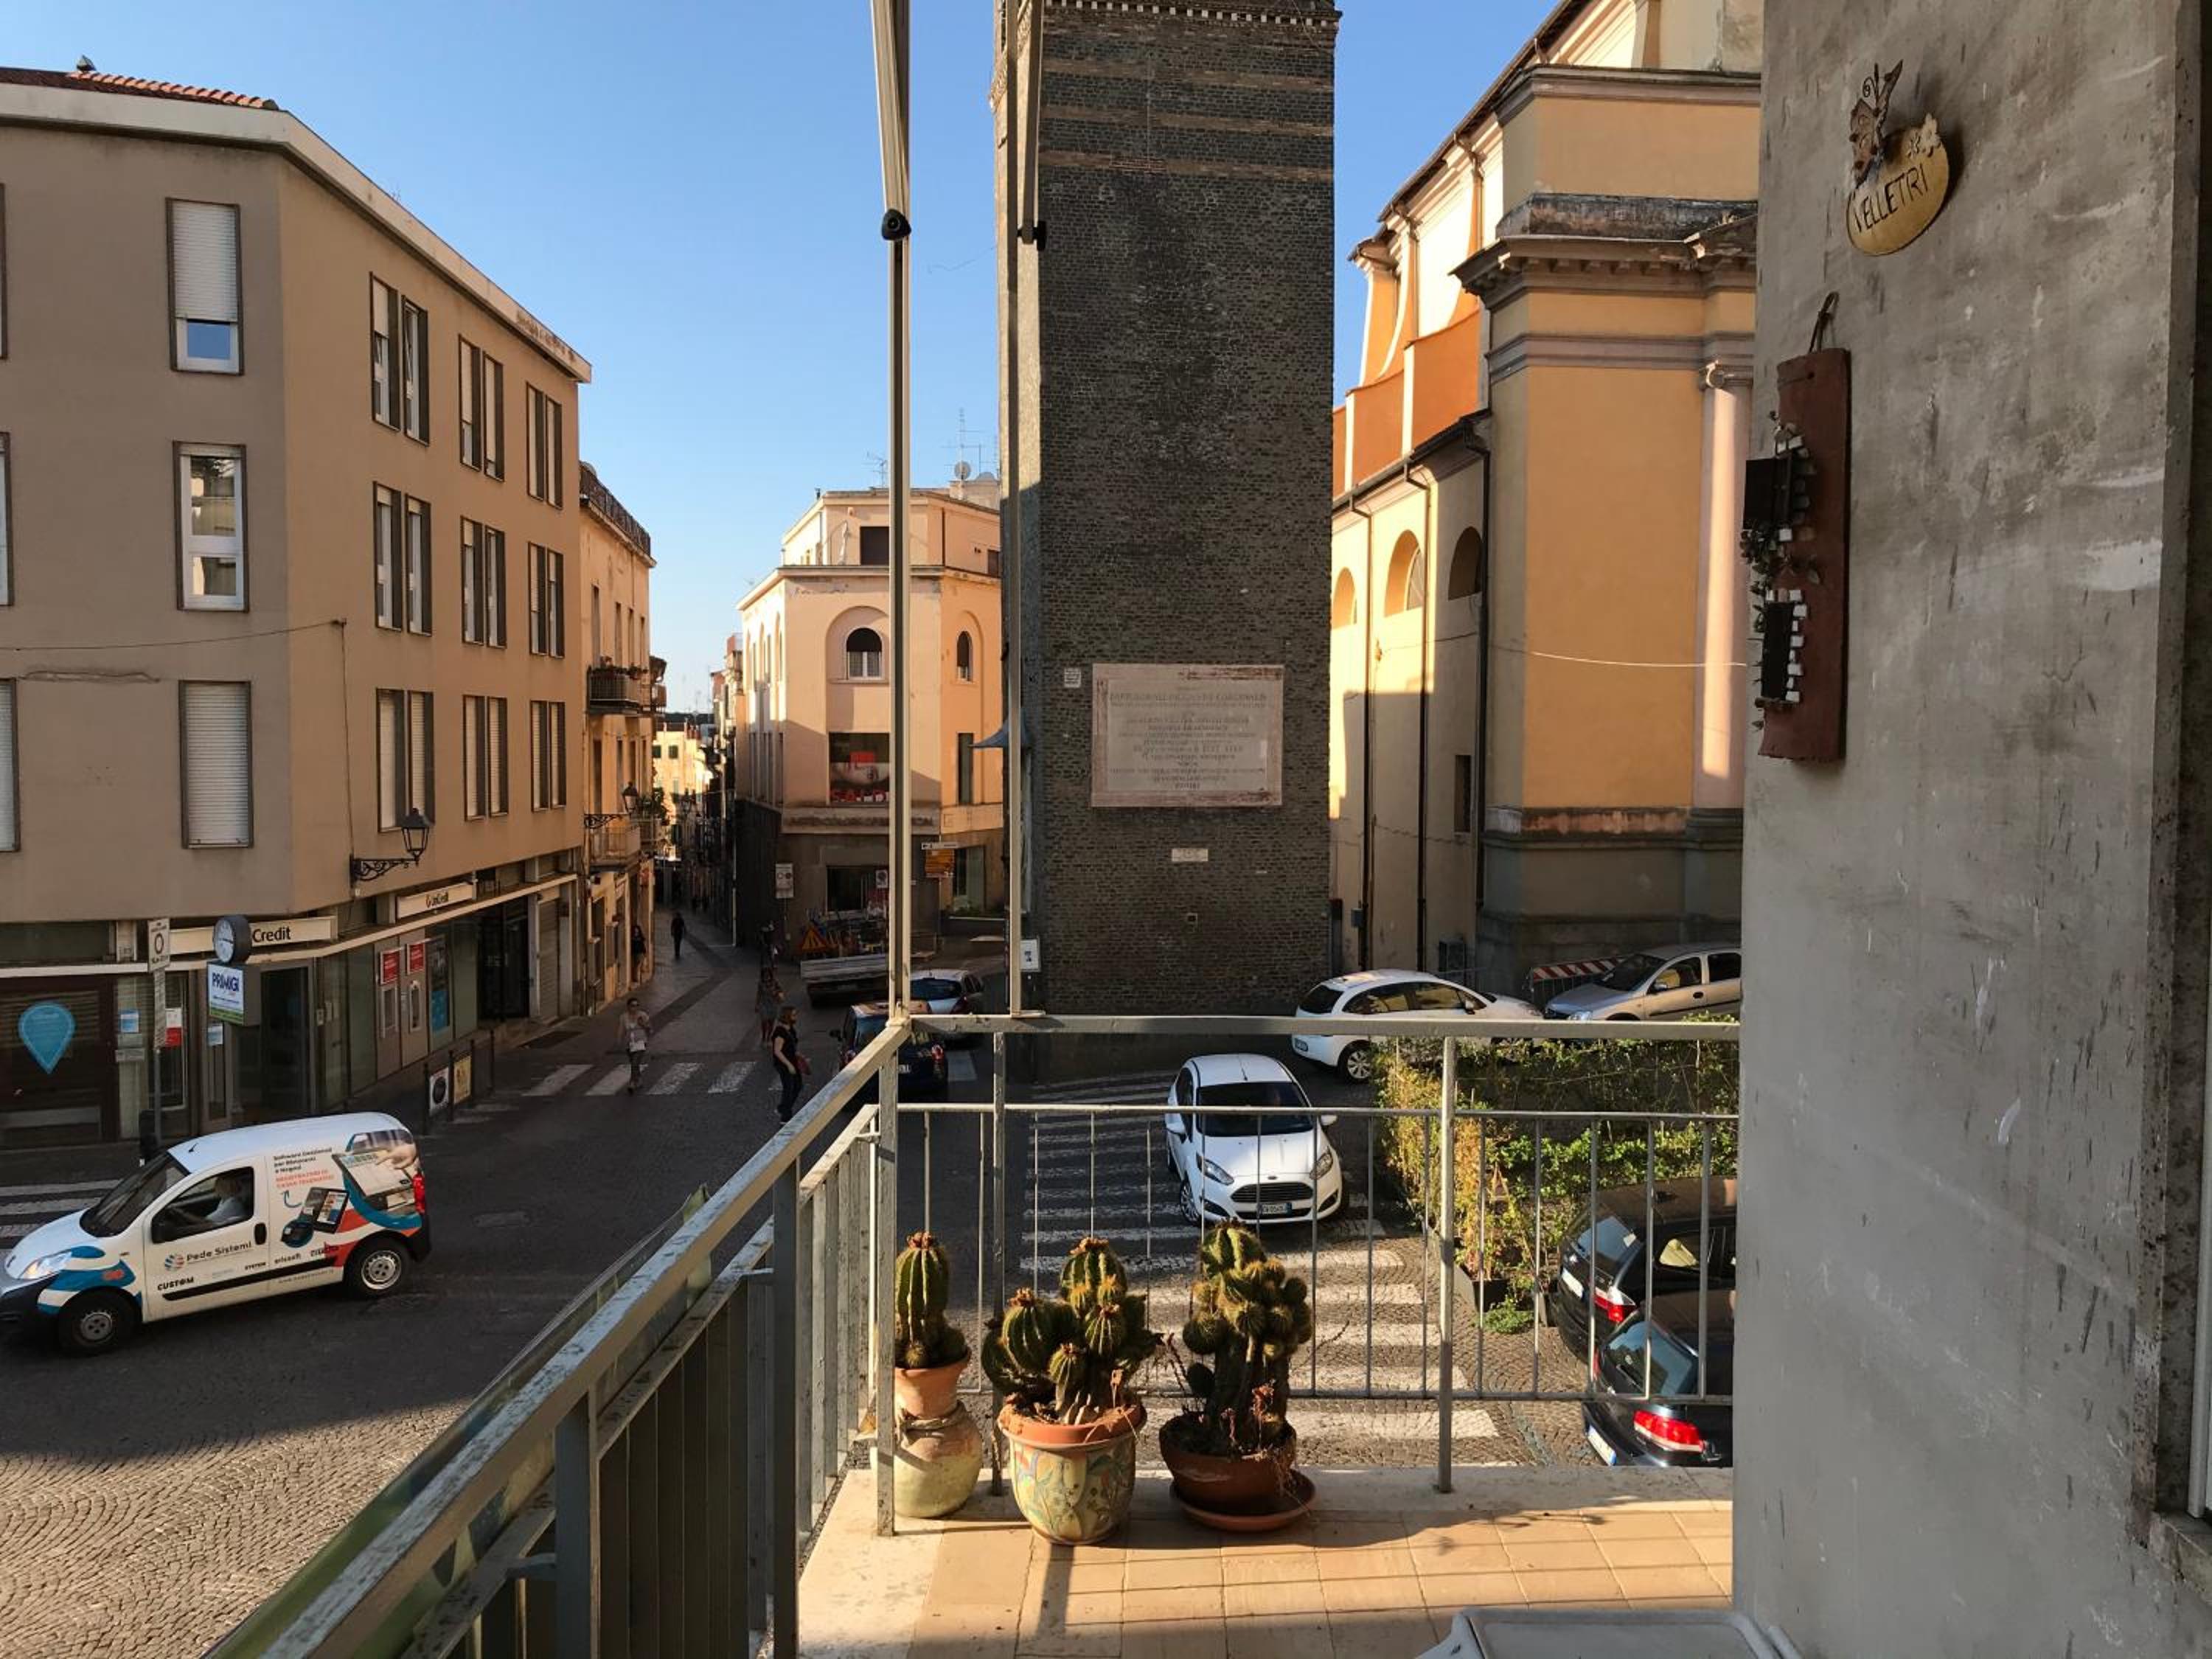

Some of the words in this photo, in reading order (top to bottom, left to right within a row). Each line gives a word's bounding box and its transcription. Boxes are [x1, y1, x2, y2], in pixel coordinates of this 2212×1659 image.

[251, 926, 291, 943] Credit
[212, 972, 240, 992] PRIMIGI
[187, 1250, 212, 1262] Pede
[215, 1241, 252, 1255] Sistemi
[157, 1276, 195, 1291] CUSTOM
